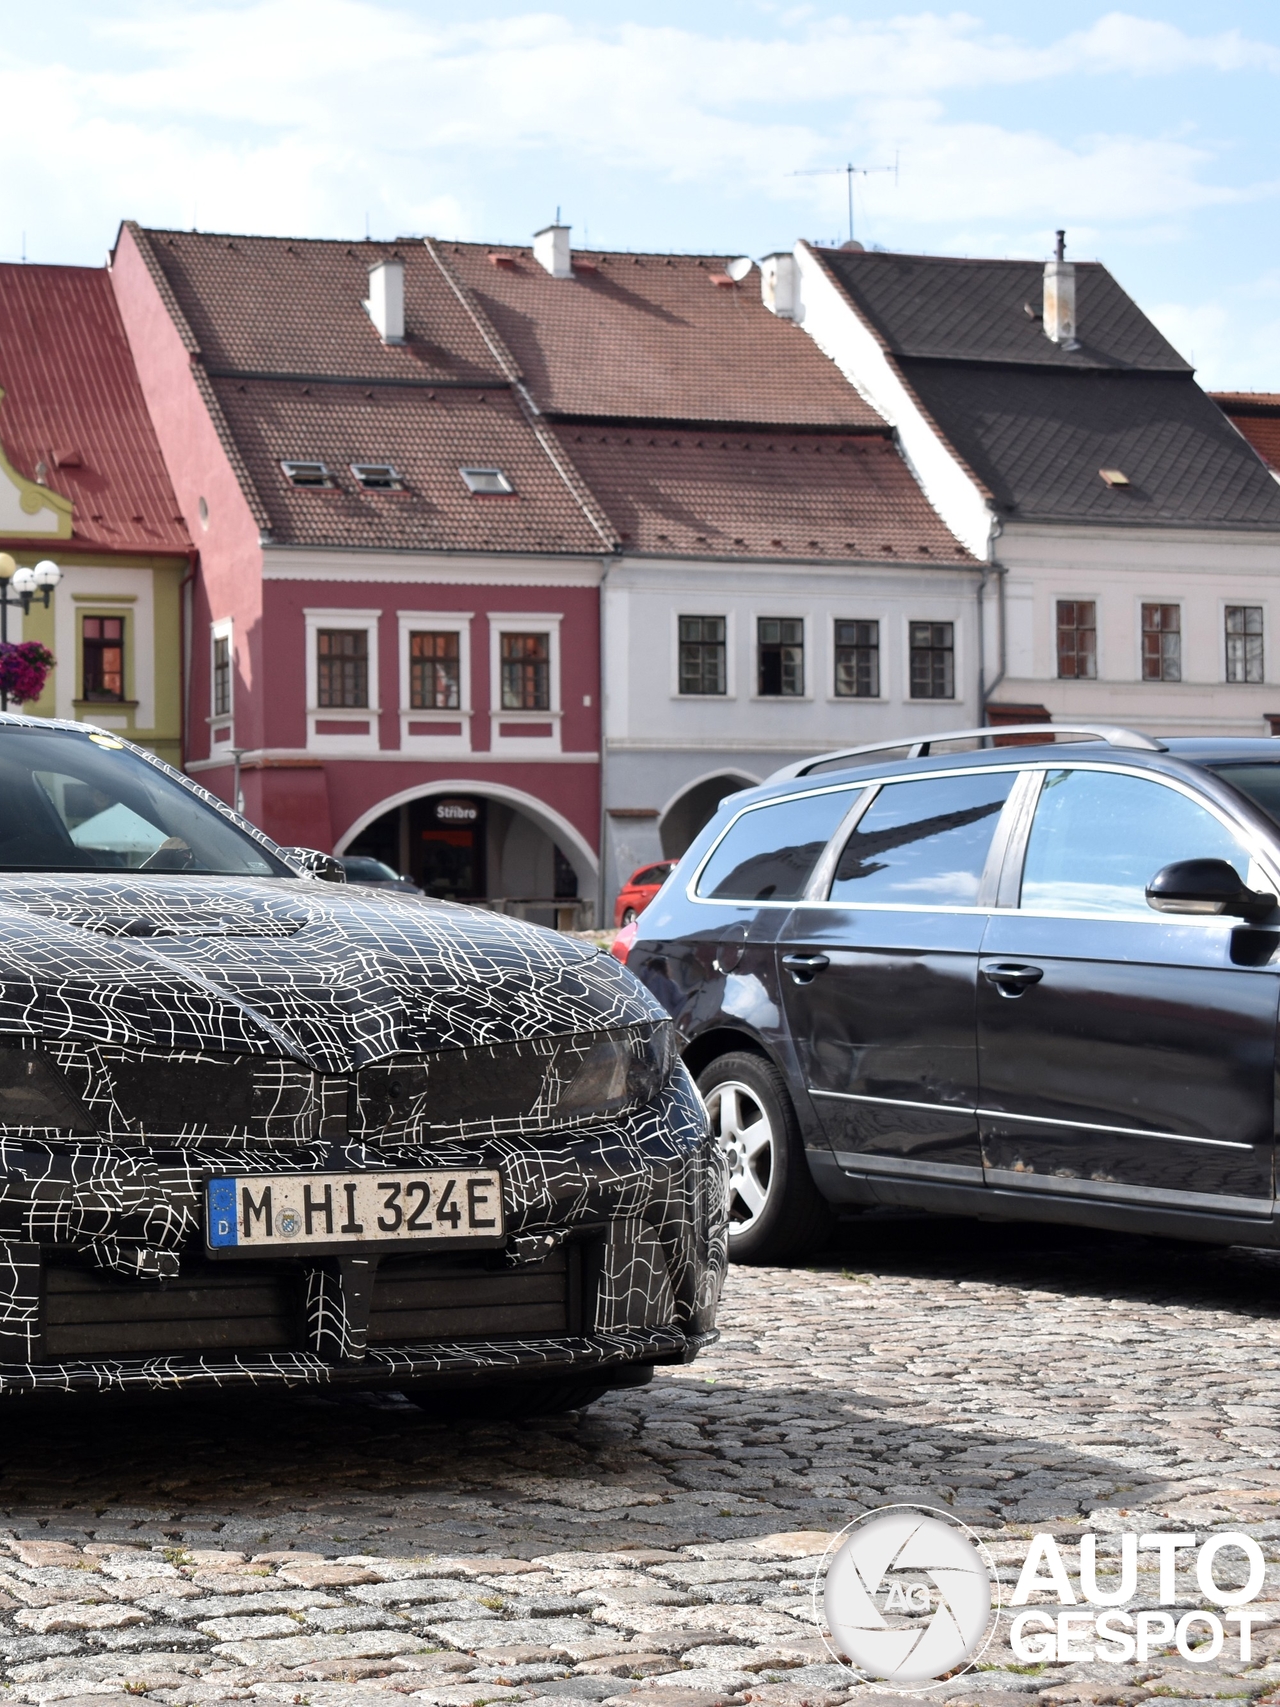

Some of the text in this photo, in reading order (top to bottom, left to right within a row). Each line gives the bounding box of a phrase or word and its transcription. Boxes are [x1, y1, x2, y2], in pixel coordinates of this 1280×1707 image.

[242, 1178, 495, 1238] M HI 324E
[218, 1220, 228, 1235] D
